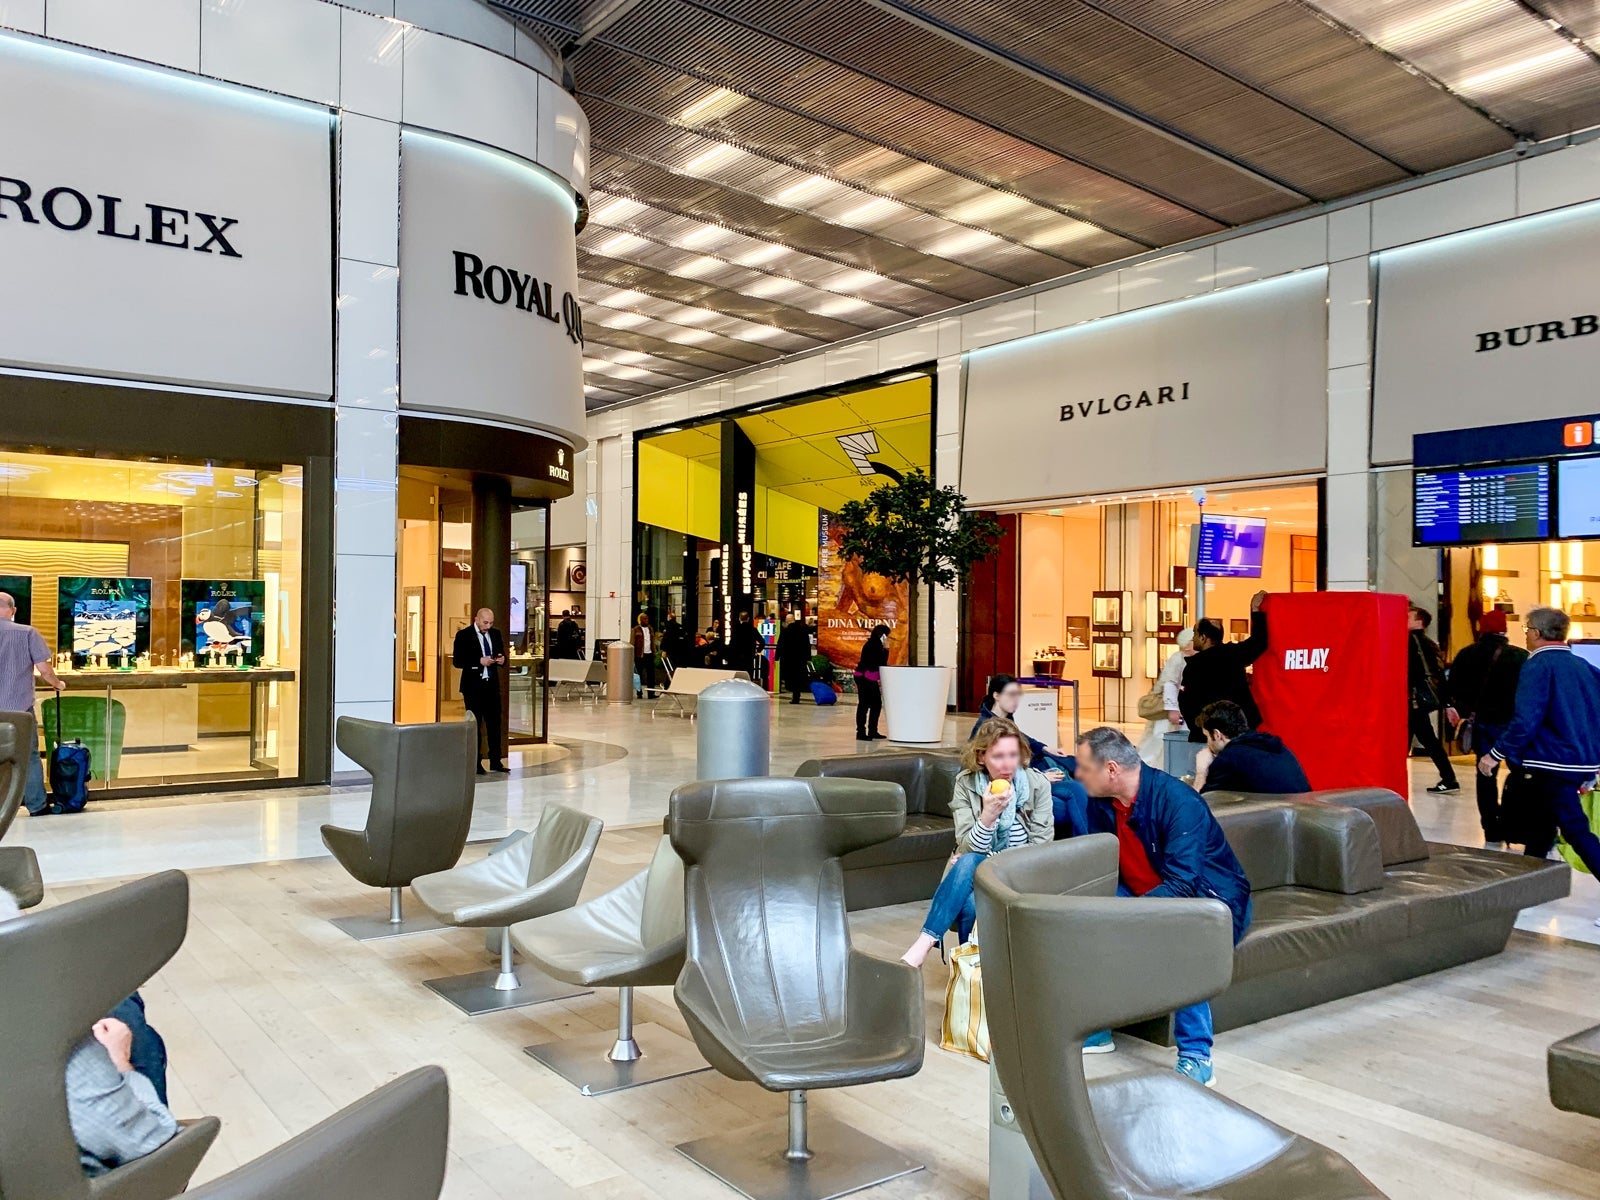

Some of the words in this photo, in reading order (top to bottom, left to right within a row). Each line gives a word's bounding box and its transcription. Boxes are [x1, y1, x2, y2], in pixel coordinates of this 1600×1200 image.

[0, 176, 242, 258] ROLEX
[452, 250, 560, 323] ROYAL
[1475, 314, 1600, 352] BURB
[1059, 381, 1190, 421] BVLGARI
[549, 465, 570, 482] ROLEX
[821, 514, 829, 547] MUSEUM
[742, 544, 752, 594] ESPACE
[90, 588, 120, 596] ROLEX
[827, 618, 854, 629] DINA
[1284, 648, 1330, 671] RELAY
